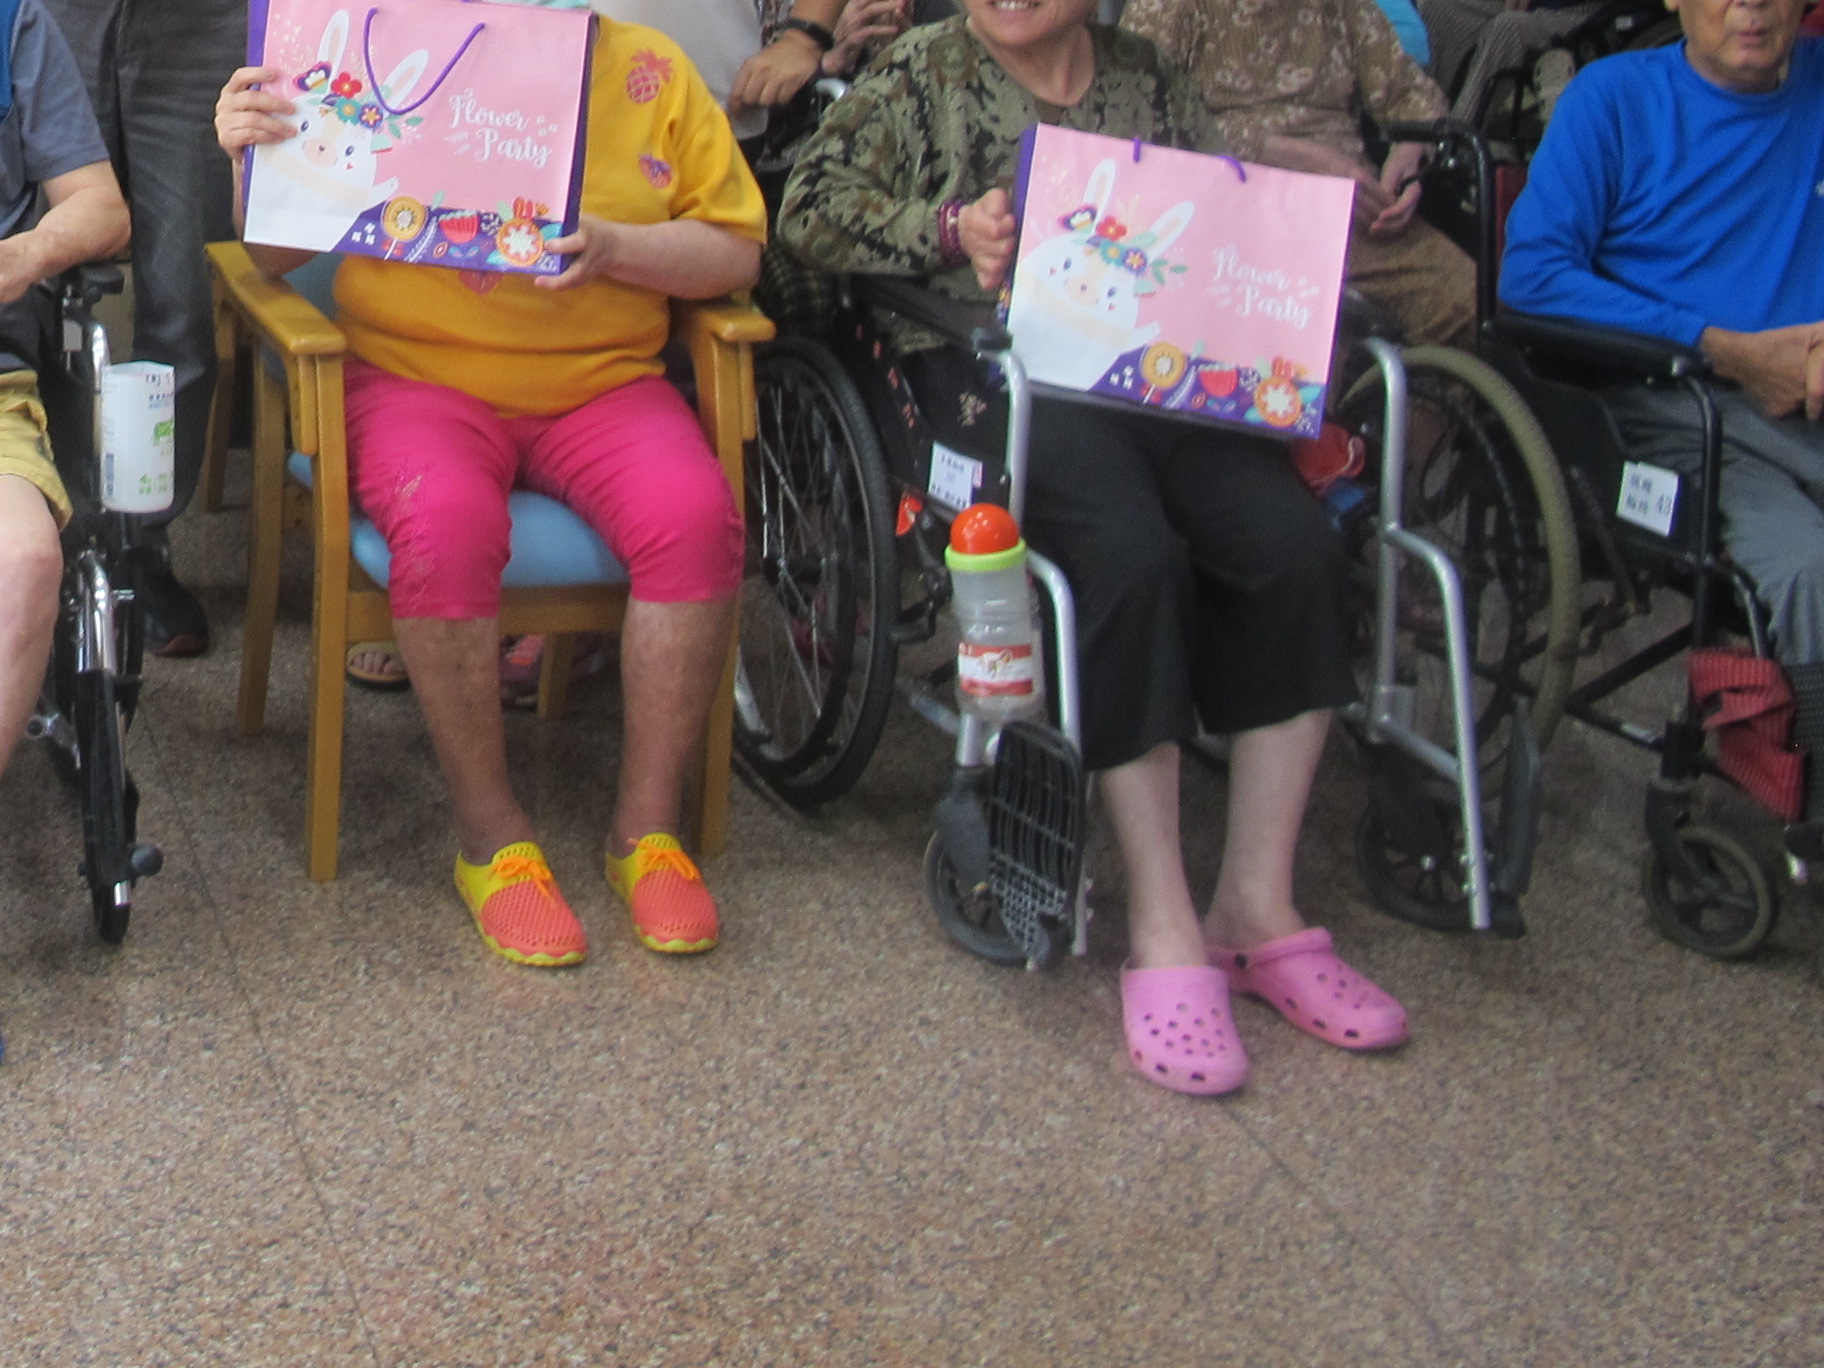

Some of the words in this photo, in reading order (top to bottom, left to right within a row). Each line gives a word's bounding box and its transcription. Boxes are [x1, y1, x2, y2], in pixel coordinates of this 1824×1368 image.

[448, 88, 530, 130] Flower
[475, 128, 553, 168] Party
[1212, 245, 1291, 289] Flower
[1236, 287, 1314, 329] Party
